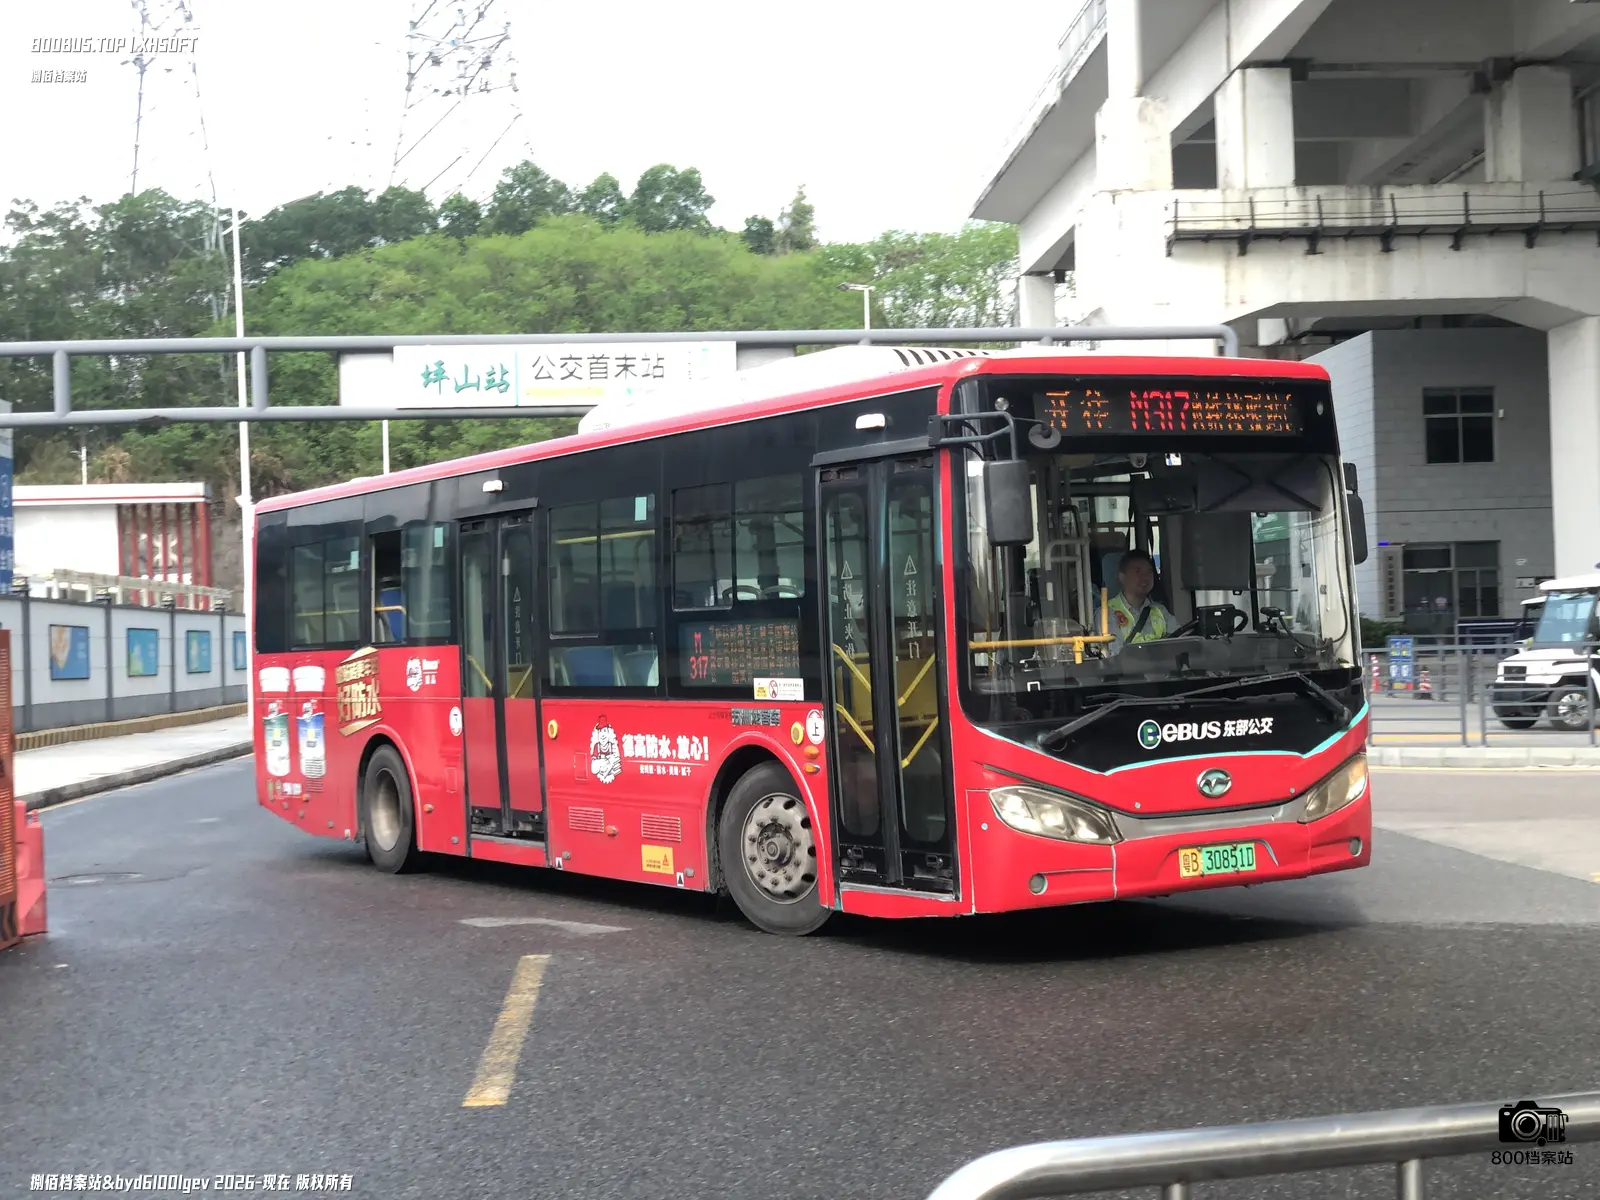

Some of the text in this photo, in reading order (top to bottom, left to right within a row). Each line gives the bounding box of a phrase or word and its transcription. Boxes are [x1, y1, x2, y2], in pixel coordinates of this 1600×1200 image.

[420, 359, 511, 396] 坪山站
[531, 353, 665, 380] 公交首末站
[693, 631, 703, 654] M
[689, 655, 709, 680] 317
[1222, 717, 1274, 737] 东部公交
